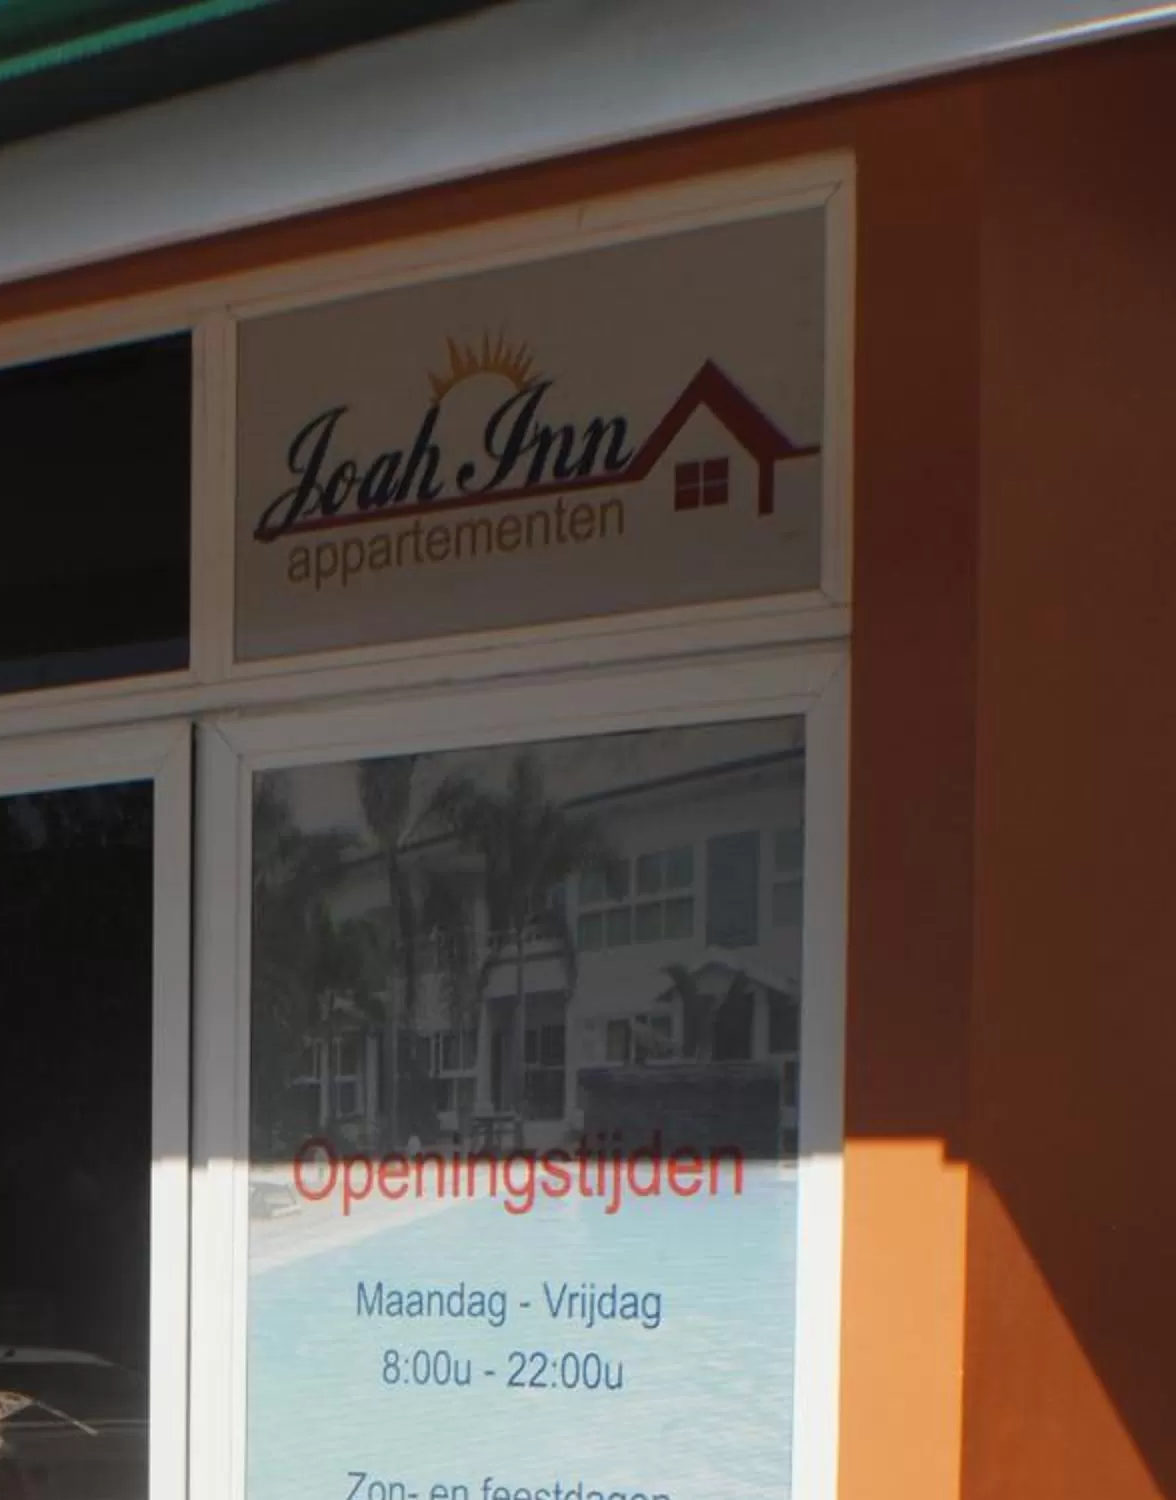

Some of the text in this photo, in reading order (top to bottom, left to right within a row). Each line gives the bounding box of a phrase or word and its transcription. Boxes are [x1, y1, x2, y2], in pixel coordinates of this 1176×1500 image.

[253, 379, 634, 541] Joah Inn
[288, 497, 624, 589] appartementen
[293, 1131, 743, 1214] Openingstijden
[356, 1281, 507, 1327] Maandag
[542, 1282, 662, 1328] Vrijdag
[382, 1350, 472, 1386] 8:00u
[507, 1352, 623, 1389] 22:00u
